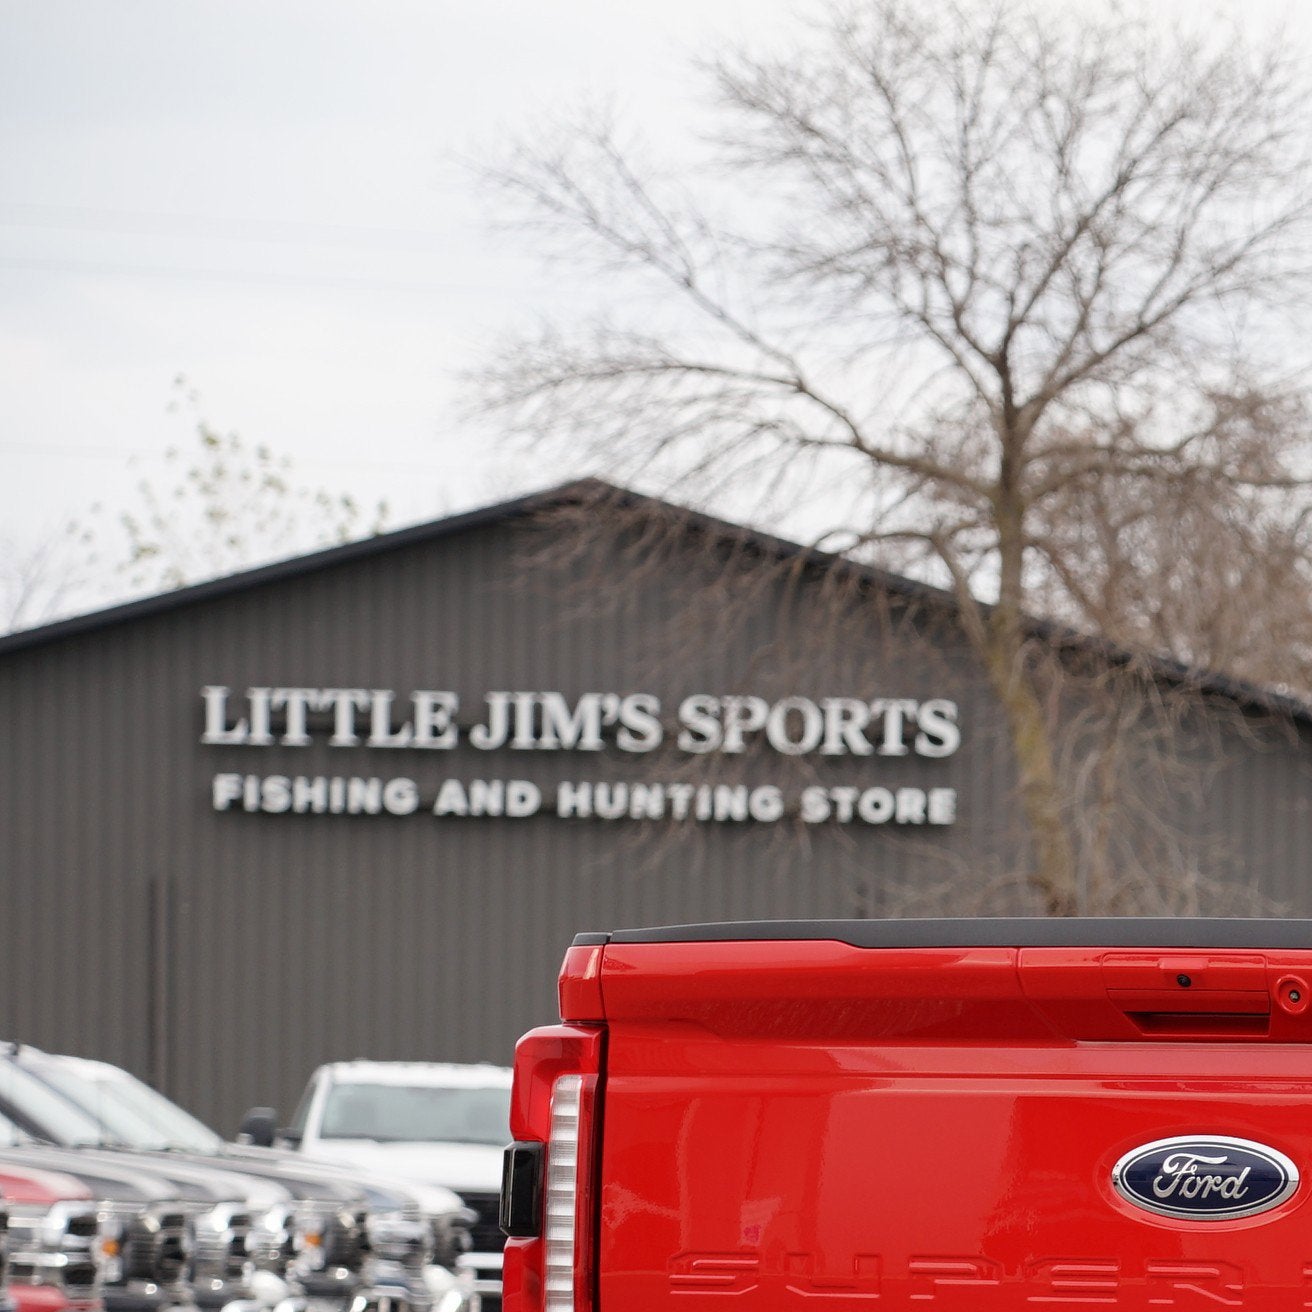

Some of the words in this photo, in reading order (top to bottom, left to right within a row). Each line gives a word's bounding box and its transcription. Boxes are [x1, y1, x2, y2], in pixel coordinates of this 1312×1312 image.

[201, 686, 459, 750] LITTLE
[470, 691, 663, 754] JIM'S
[677, 694, 961, 758] SPORTS
[213, 773, 418, 815] FISHING
[434, 778, 542, 817] AND
[557, 781, 785, 824] HUNTING
[799, 786, 957, 825] STORE
[1153, 1152, 1252, 1199] Ford
[669, 1251, 1244, 1307] SUPER
